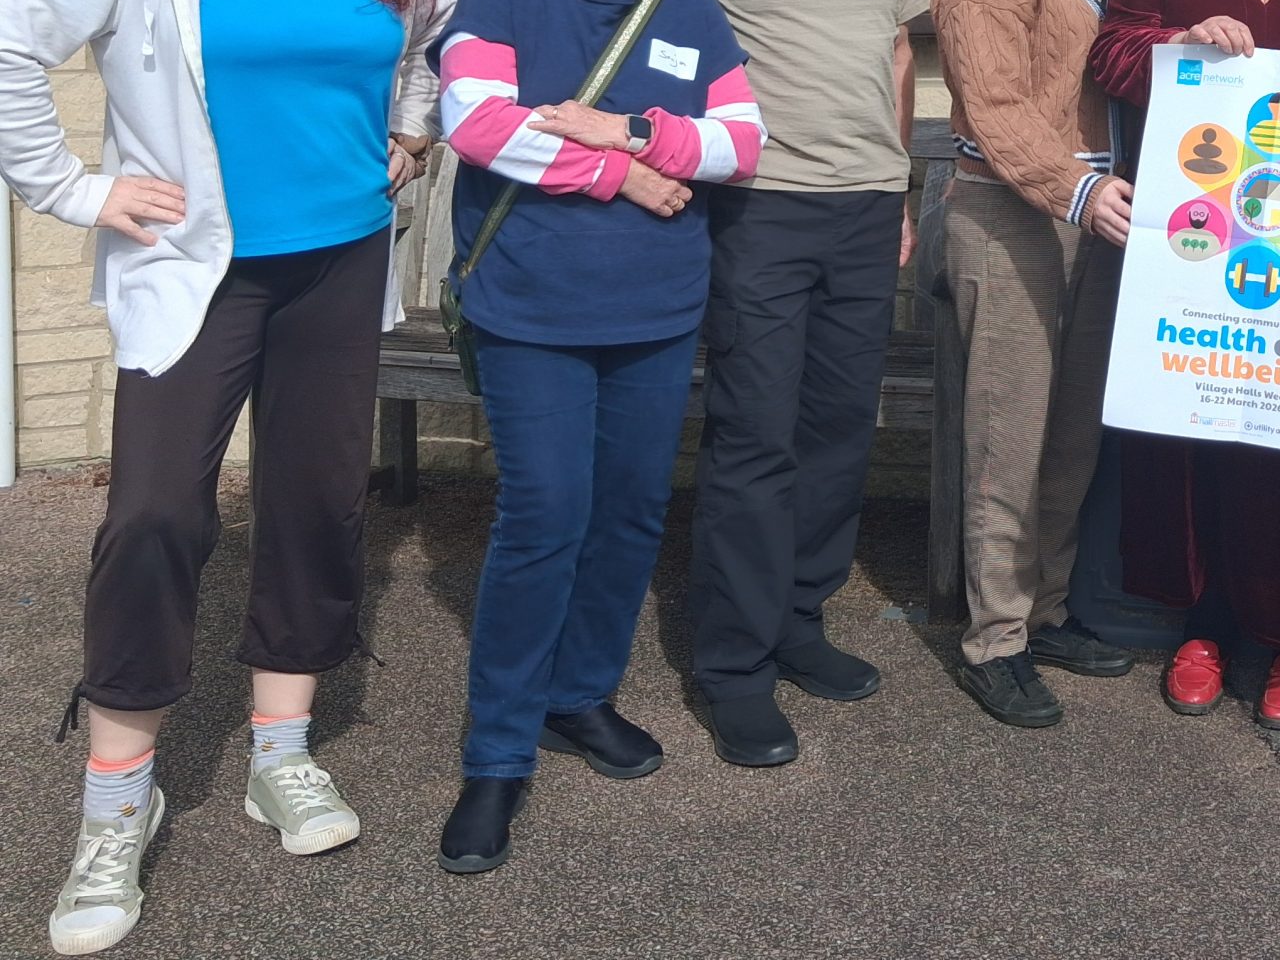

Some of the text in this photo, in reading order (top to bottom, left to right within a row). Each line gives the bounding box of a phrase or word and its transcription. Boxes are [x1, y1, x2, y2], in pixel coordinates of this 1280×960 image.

[1179, 72, 1244, 85] acre network
[1182, 308, 1240, 324] Connecting
[1156, 317, 1267, 355] health
[1195, 382, 1234, 395] Village
[1235, 386, 1262, 398] Halls
[1200, 395, 1225, 405] 16-22
[1227, 397, 1258, 409] March
[1253, 423, 1275, 435] utility
